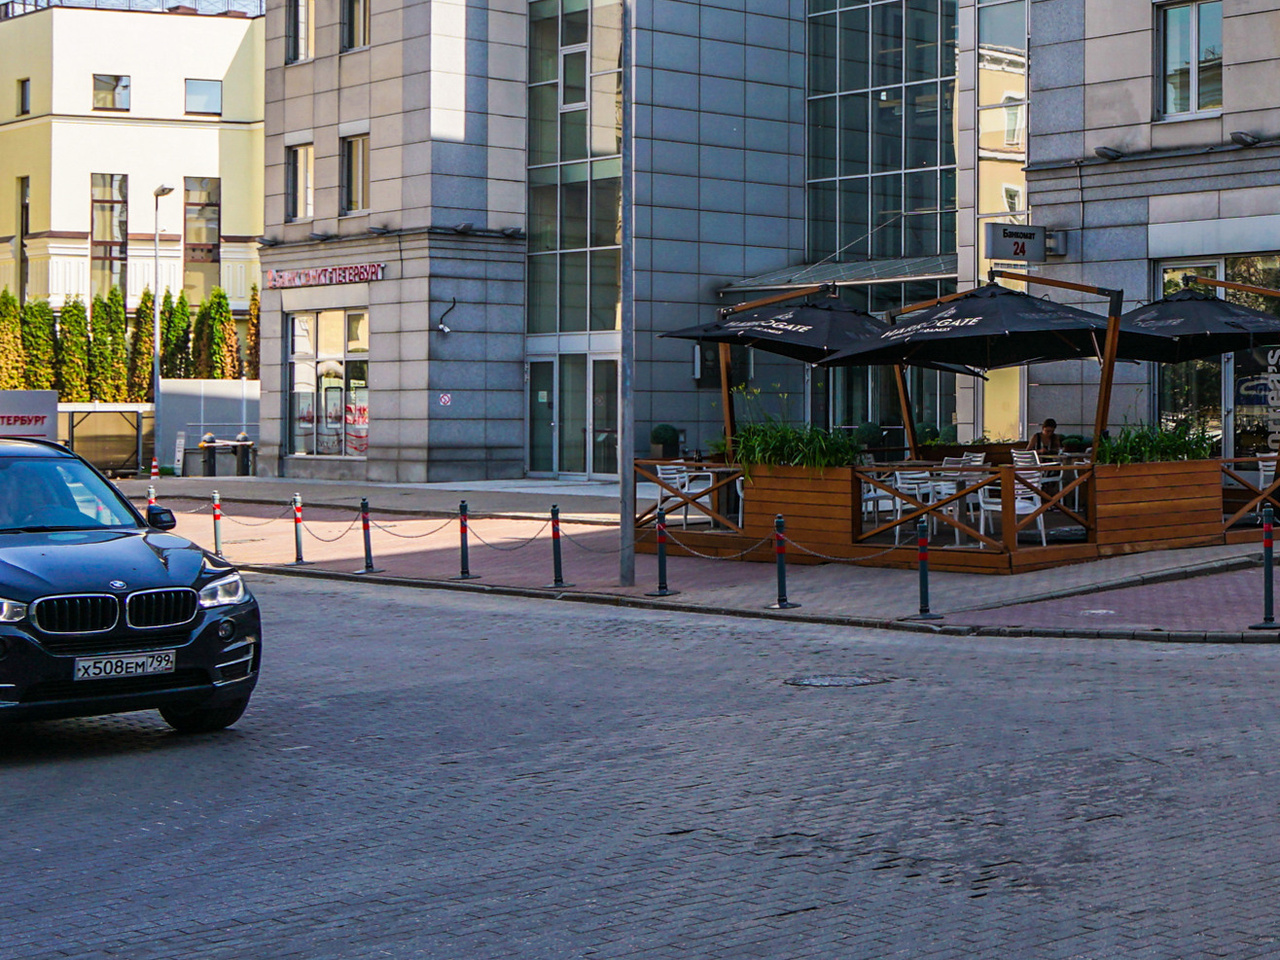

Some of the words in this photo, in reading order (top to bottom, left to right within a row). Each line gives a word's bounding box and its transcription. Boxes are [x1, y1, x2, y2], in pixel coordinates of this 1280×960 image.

[1003, 228, 1036, 240] Банкомат
[1013, 241, 1026, 256] 24
[301, 263, 384, 286] САНКТ-ПЕТЕРБУРГ
